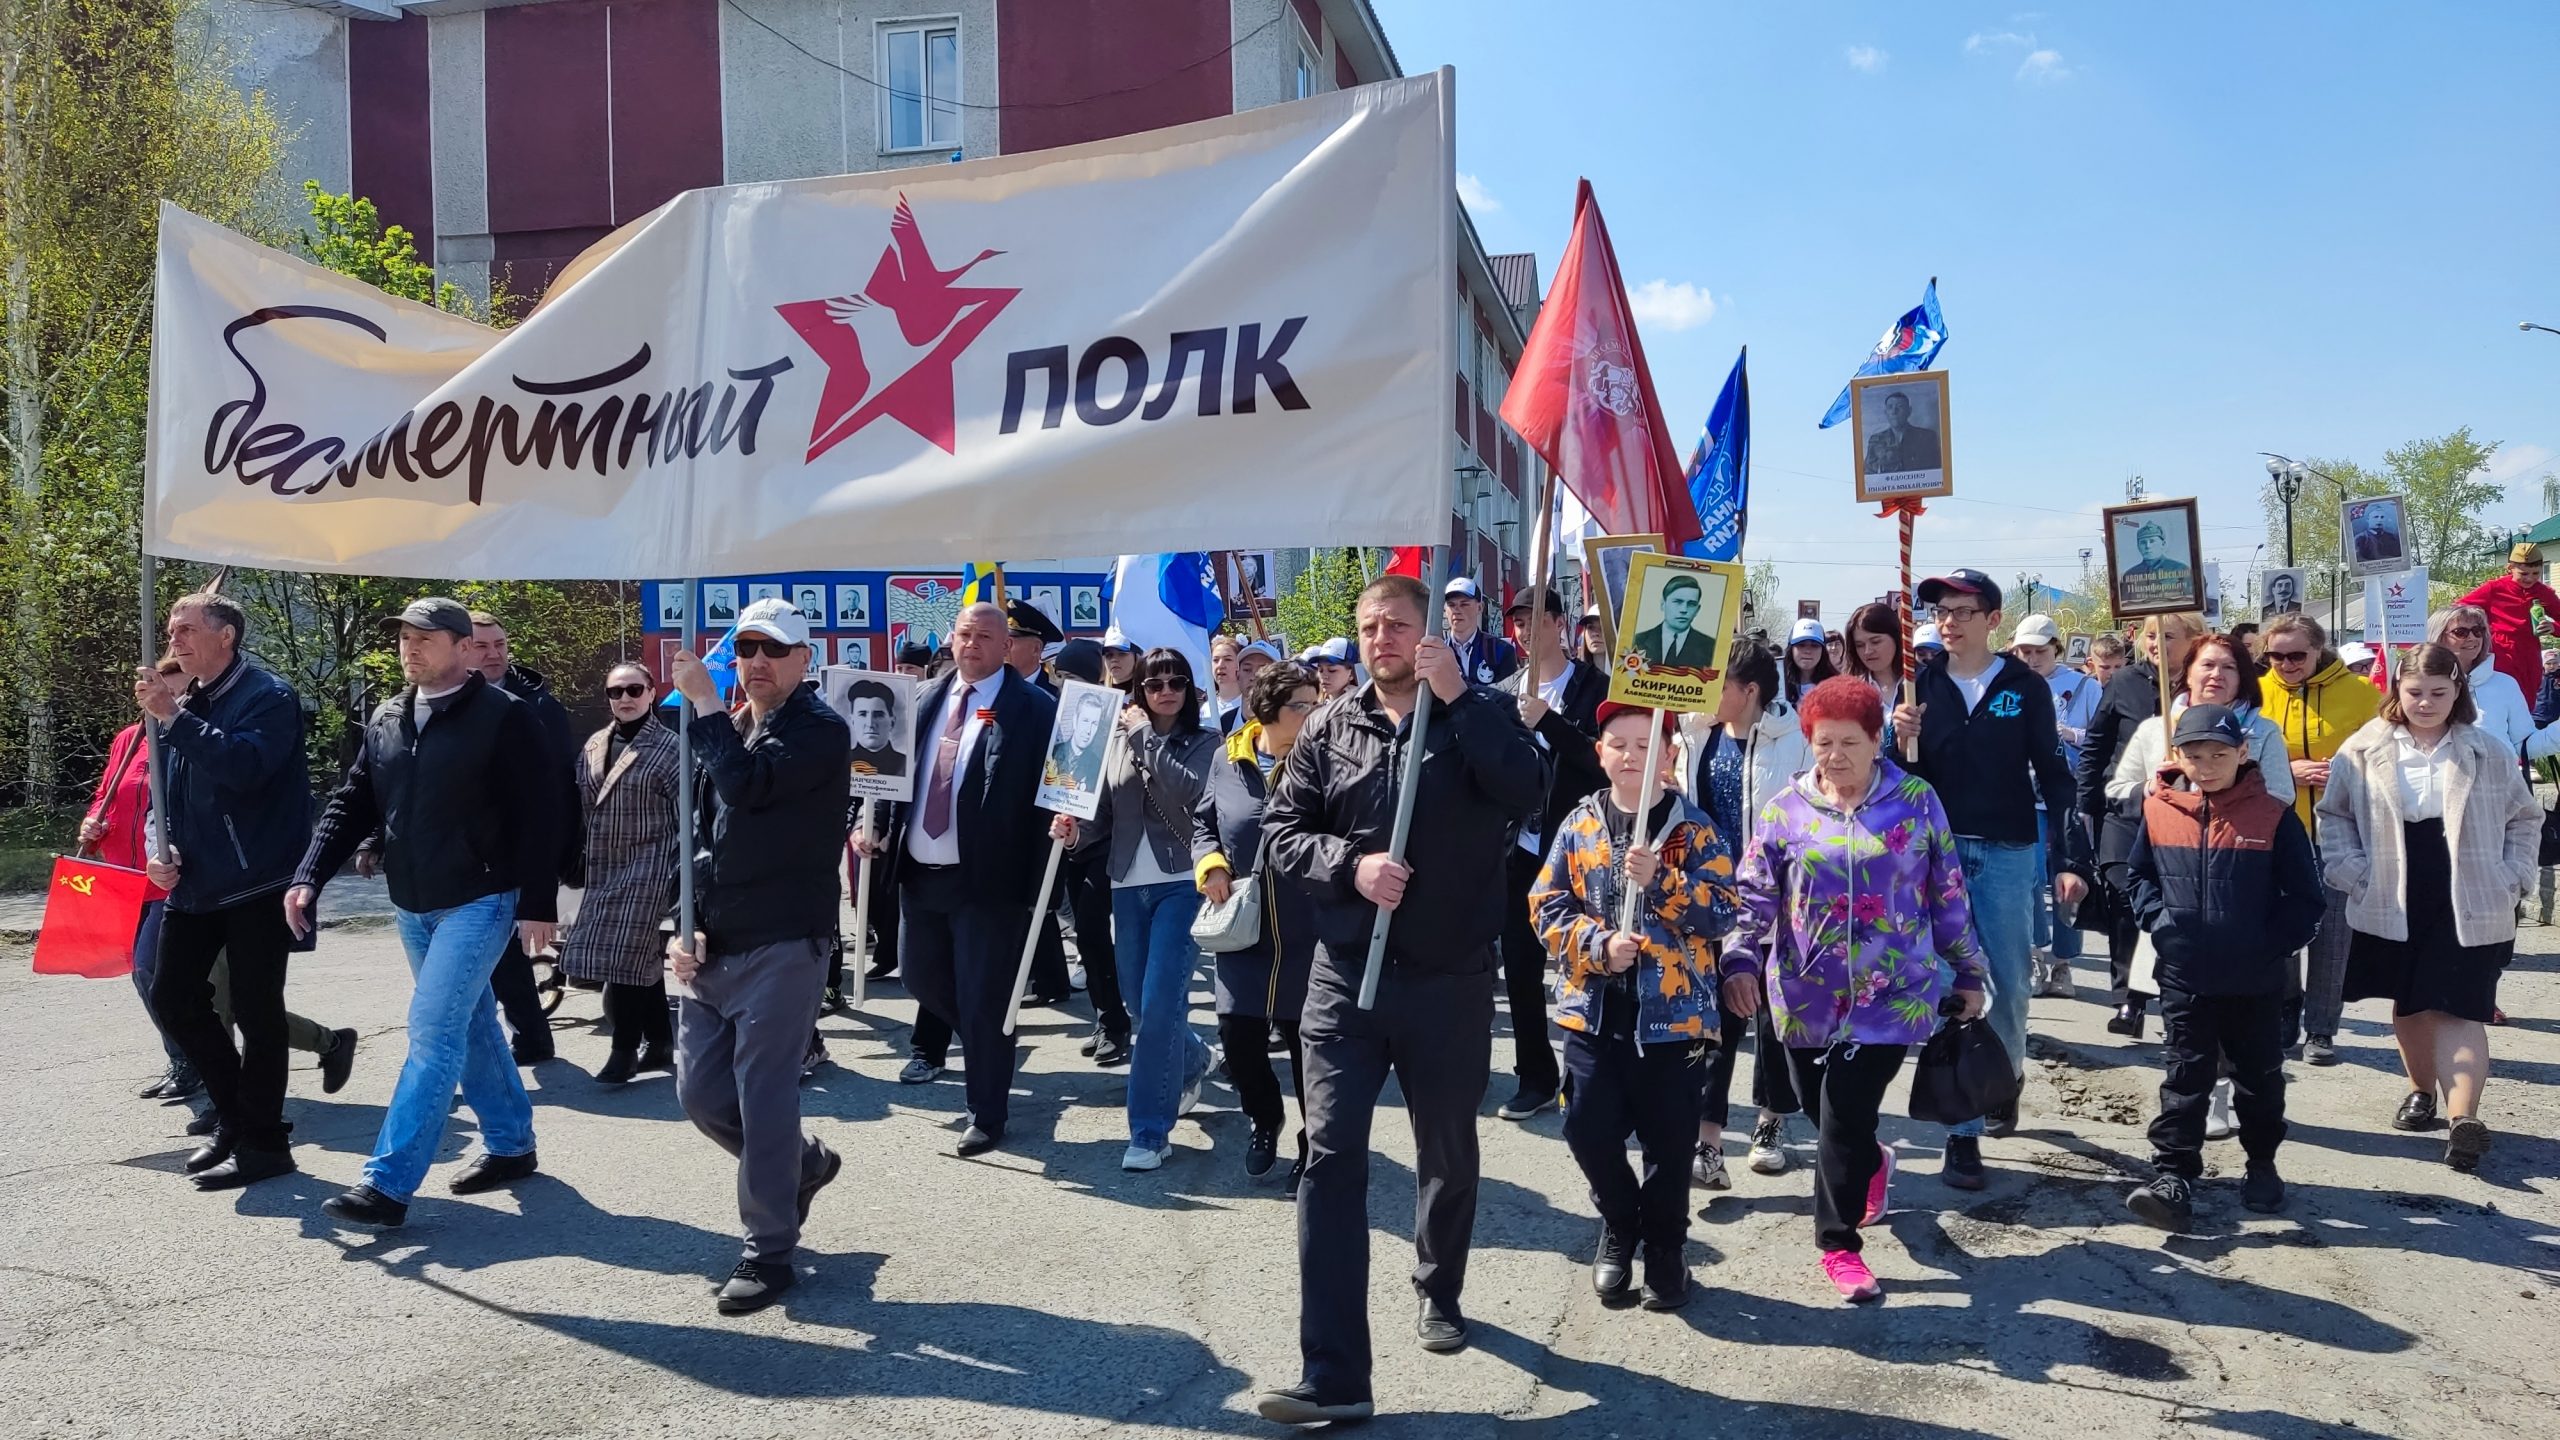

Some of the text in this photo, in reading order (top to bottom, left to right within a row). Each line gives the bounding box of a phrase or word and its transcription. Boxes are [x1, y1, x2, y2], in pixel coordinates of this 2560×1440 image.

[998, 315, 1311, 435] ПОЛК
[1624, 688, 1666, 700] Александр
[1667, 694, 1707, 704] Иванович
[1631, 678, 1704, 696] СКИРИДОВ
